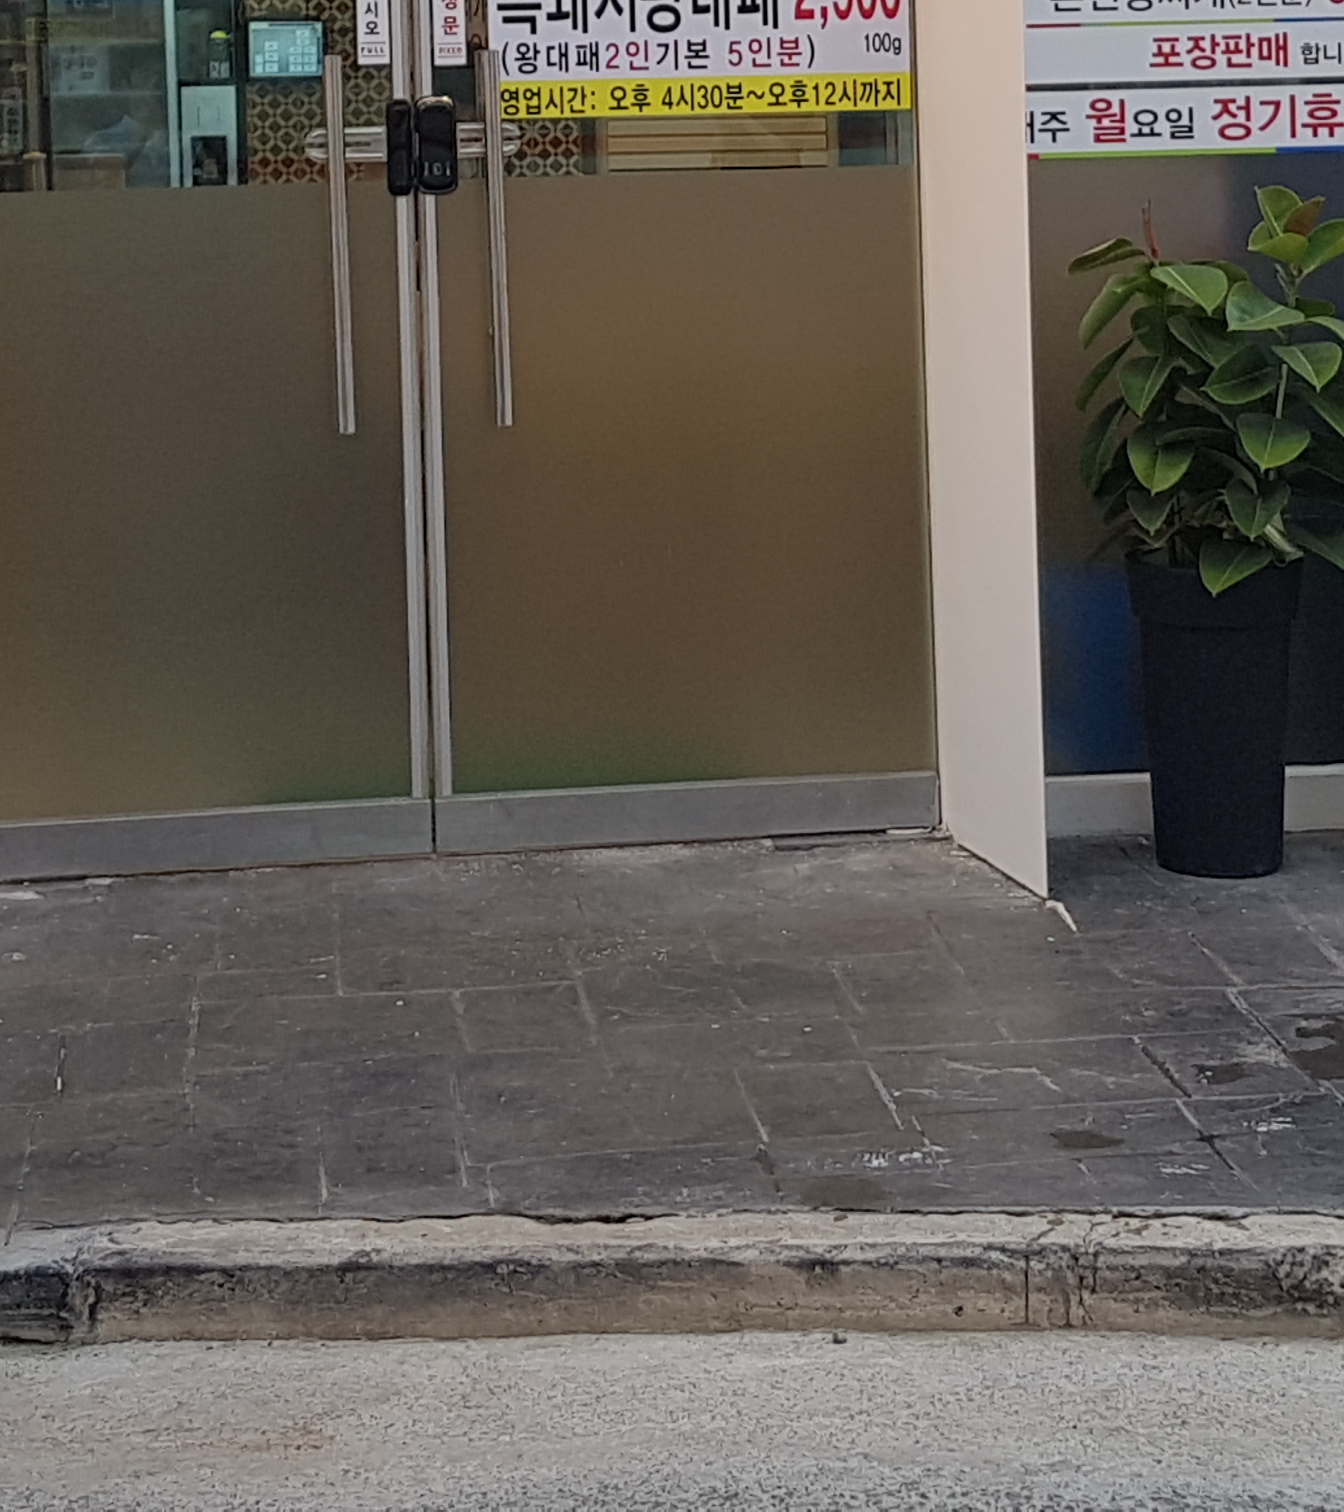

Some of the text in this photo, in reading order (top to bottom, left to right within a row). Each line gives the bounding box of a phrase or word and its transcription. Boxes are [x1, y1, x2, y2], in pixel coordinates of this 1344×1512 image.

[727, 34, 816, 69] 5인분)
[864, 32, 903, 56] 100g
[1149, 32, 1289, 71] 포장판매
[500, 85, 597, 116] 영업시간:
[609, 84, 651, 112] 오후
[1086, 97, 1195, 144] 월요일
